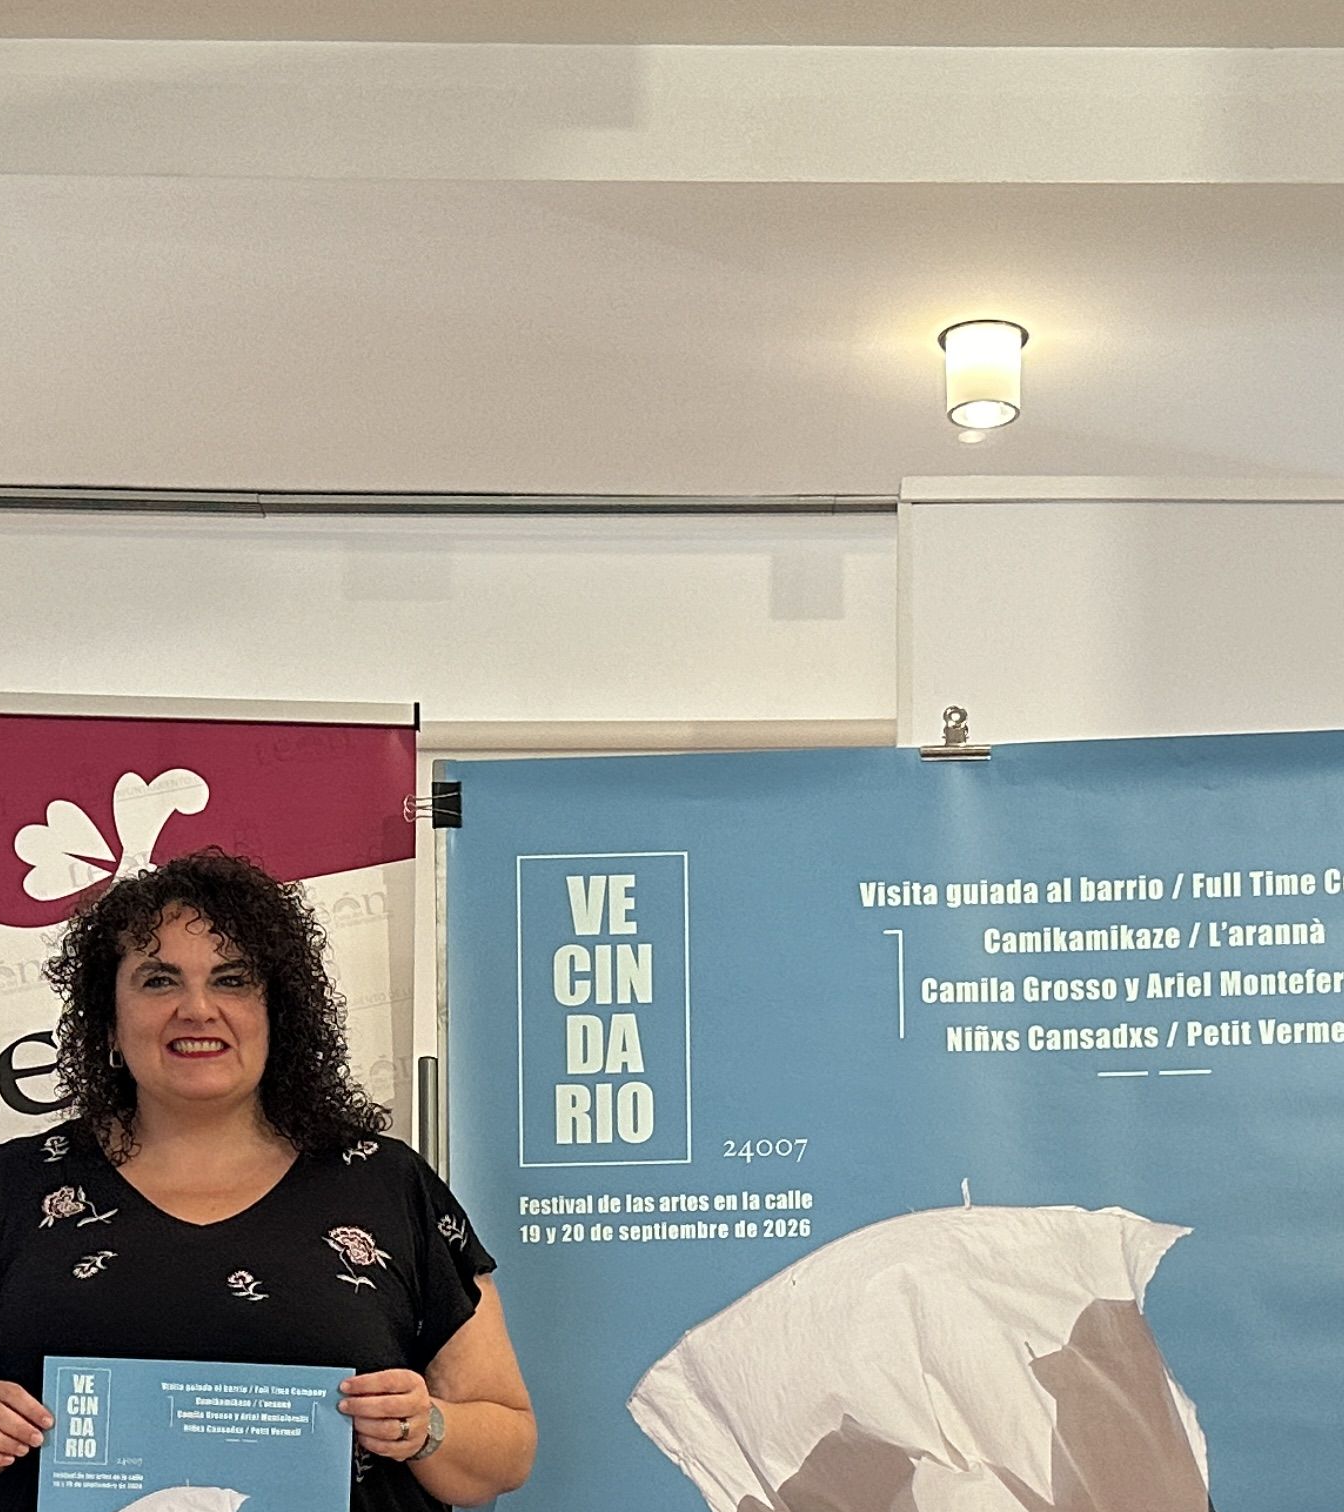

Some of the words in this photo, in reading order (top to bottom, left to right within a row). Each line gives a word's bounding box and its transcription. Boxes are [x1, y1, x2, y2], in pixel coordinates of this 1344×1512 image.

[566, 875, 636, 935] VE
[859, 881, 938, 907] Visita
[946, 878, 1038, 908] guiada
[1046, 877, 1072, 903] al
[1079, 875, 1164, 902] barrio
[1171, 873, 1185, 899] /
[1192, 872, 1242, 898] Full
[1248, 871, 1316, 897] Time
[984, 925, 1181, 953] Camikamikaze
[1188, 922, 1201, 948] /
[554, 944, 652, 1005] CIN
[921, 977, 1015, 1003] Camila
[1023, 976, 1117, 1002] Grosso
[1124, 977, 1140, 1002] y
[1146, 972, 1212, 998] Ariel
[567, 1014, 644, 1074] DA
[946, 1026, 1020, 1051] Niñxs
[1028, 1023, 1159, 1051] Cansadxs
[1166, 1021, 1179, 1047] /
[1187, 1020, 1252, 1047] Petit
[556, 1082, 653, 1144] RIO
[723, 1138, 808, 1164] 24007
[519, 1194, 593, 1215] Festival
[597, 1194, 621, 1214] de
[625, 1194, 655, 1213] las
[659, 1194, 710, 1212] artes
[713, 1193, 738, 1211] en
[742, 1191, 760, 1210] la
[764, 1189, 813, 1210] calle
[519, 1224, 541, 1243] 19
[545, 1227, 556, 1244] y
[561, 1223, 585, 1242] 20
[590, 1223, 614, 1242] de
[618, 1221, 729, 1242] septiembre
[734, 1220, 758, 1239] de
[763, 1218, 811, 1239] 2026
[73, 1374, 95, 1394] VE
[67, 1395, 99, 1416] CIN
[69, 1417, 94, 1437] DA
[65, 1438, 97, 1459] RIO
